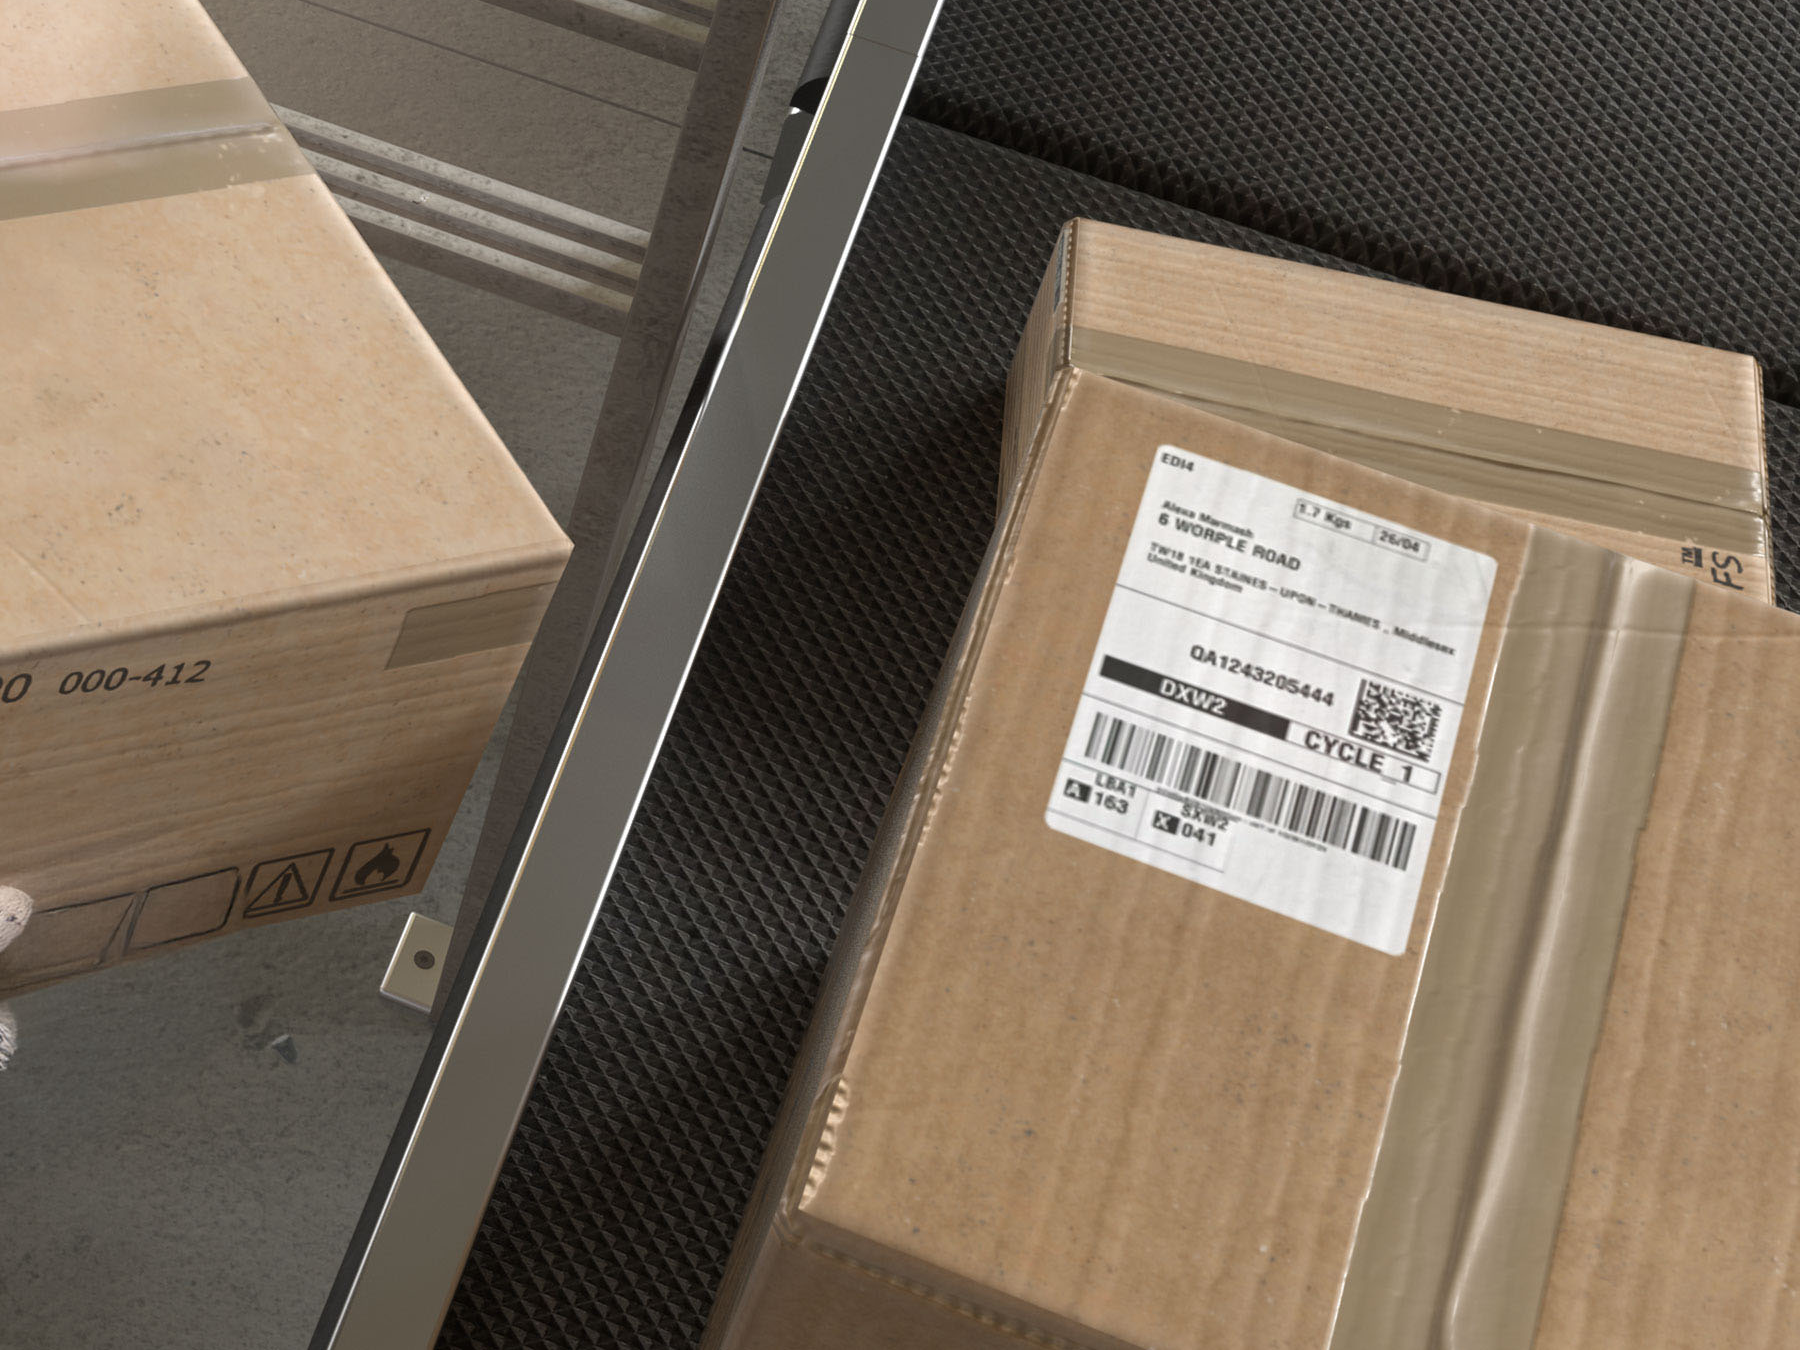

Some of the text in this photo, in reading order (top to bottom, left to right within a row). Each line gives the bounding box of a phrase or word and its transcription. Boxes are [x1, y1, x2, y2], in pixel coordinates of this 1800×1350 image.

[1161, 452, 1195, 472] EDI4
[1323, 511, 1353, 530] Kgs
[1158, 512, 1301, 571] 6 WORPLE ROAD
[1147, 552, 1244, 593] United Kingdom
[1214, 564, 1268, 590] STAINES
[1279, 585, 1317, 606] UPON
[57, 660, 212, 695] 000-412
[1189, 644, 1336, 708] QA1243205444
[1159, 678, 1228, 716] DXW2
[1303, 730, 1386, 774] CYCLE
[1094, 792, 1130, 816] 163
[1180, 822, 1217, 848] 041
